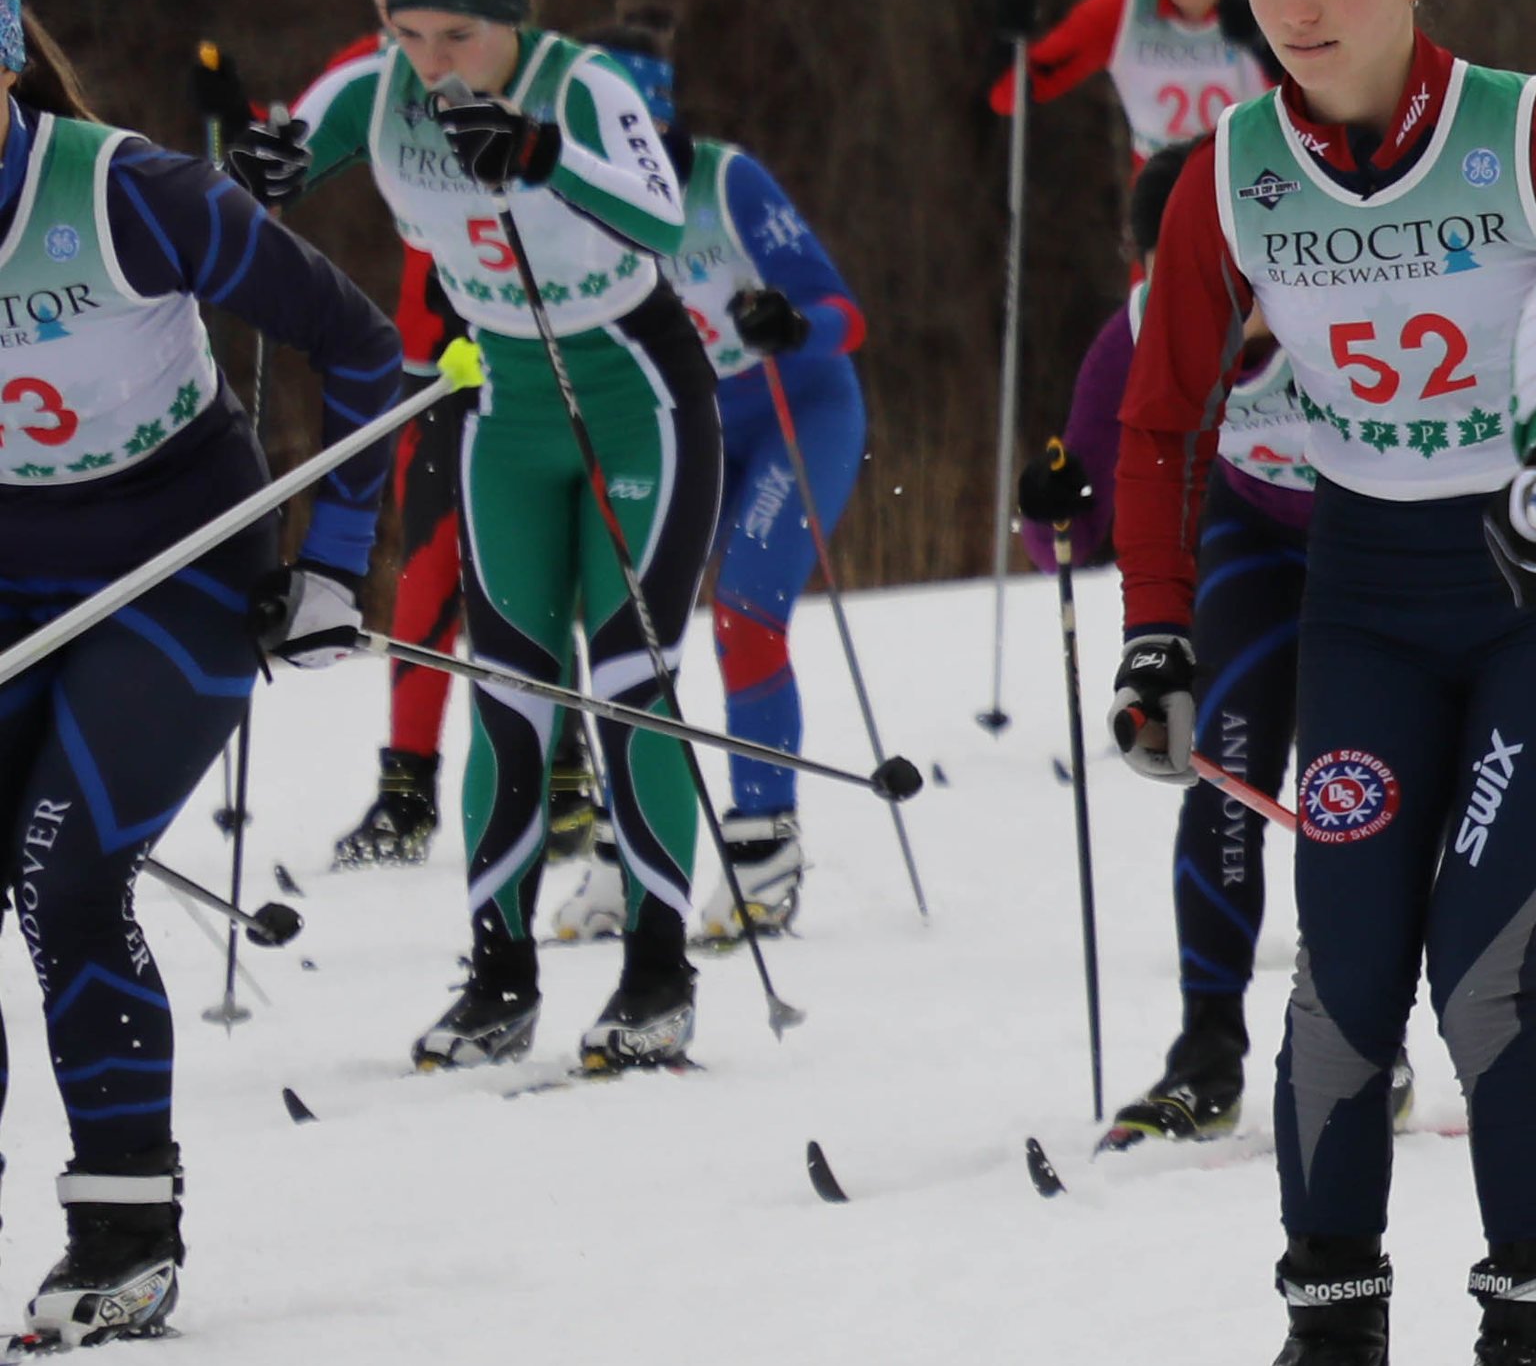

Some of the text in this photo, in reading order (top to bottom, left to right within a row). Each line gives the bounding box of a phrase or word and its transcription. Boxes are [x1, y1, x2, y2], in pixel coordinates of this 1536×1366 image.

[1262, 212, 1510, 266] PROCTOR
[1267, 261, 1439, 288] BLACKWATER
[1329, 313, 1477, 404] 52
[0, 377, 78, 447] 3
[1338, 749, 1396, 784] SCHOOL
[1221, 711, 1249, 887] ANOVER
[1349, 810, 1393, 841] SKIING
[1303, 1276, 1392, 1302] ROSSIGNO
